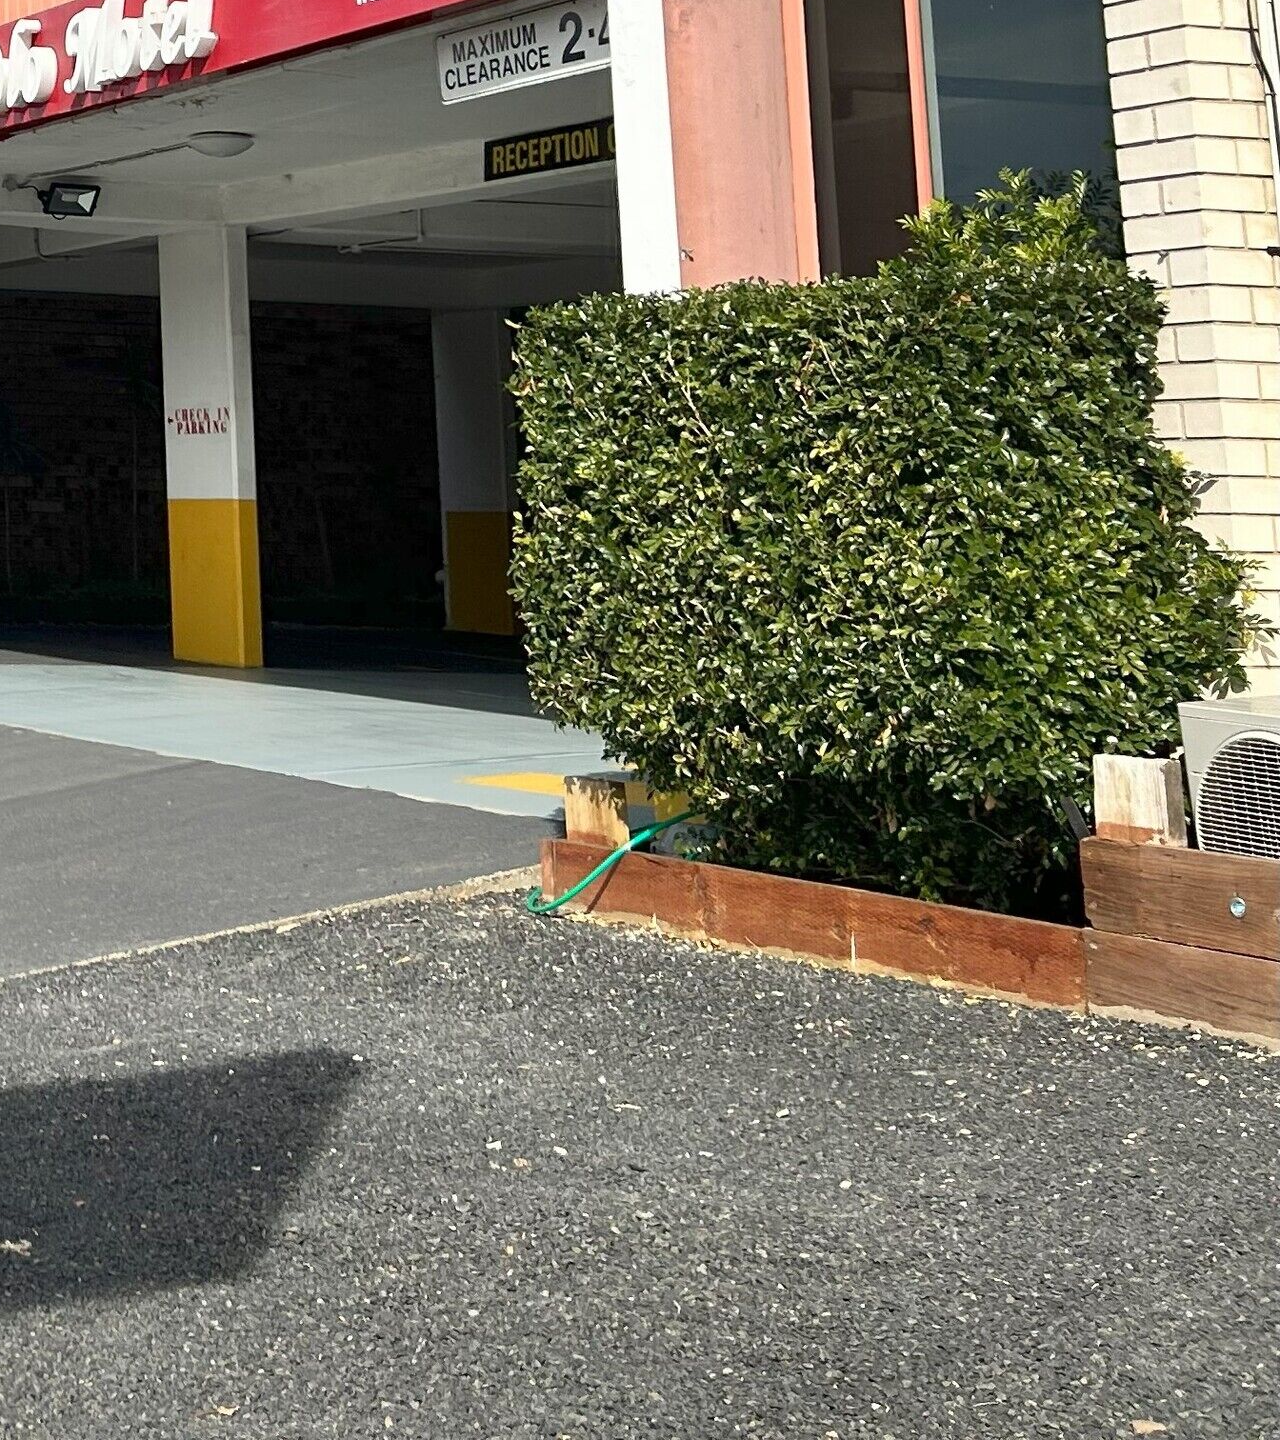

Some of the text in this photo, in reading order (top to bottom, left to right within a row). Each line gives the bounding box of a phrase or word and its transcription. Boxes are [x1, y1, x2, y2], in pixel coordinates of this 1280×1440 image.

[453, 23, 537, 63] MAXIMUM
[444, 45, 551, 90] CLEARANCE
[492, 127, 599, 175] RECEPTION
[175, 407, 231, 422] CHECK IN
[177, 420, 228, 435] PARKING
